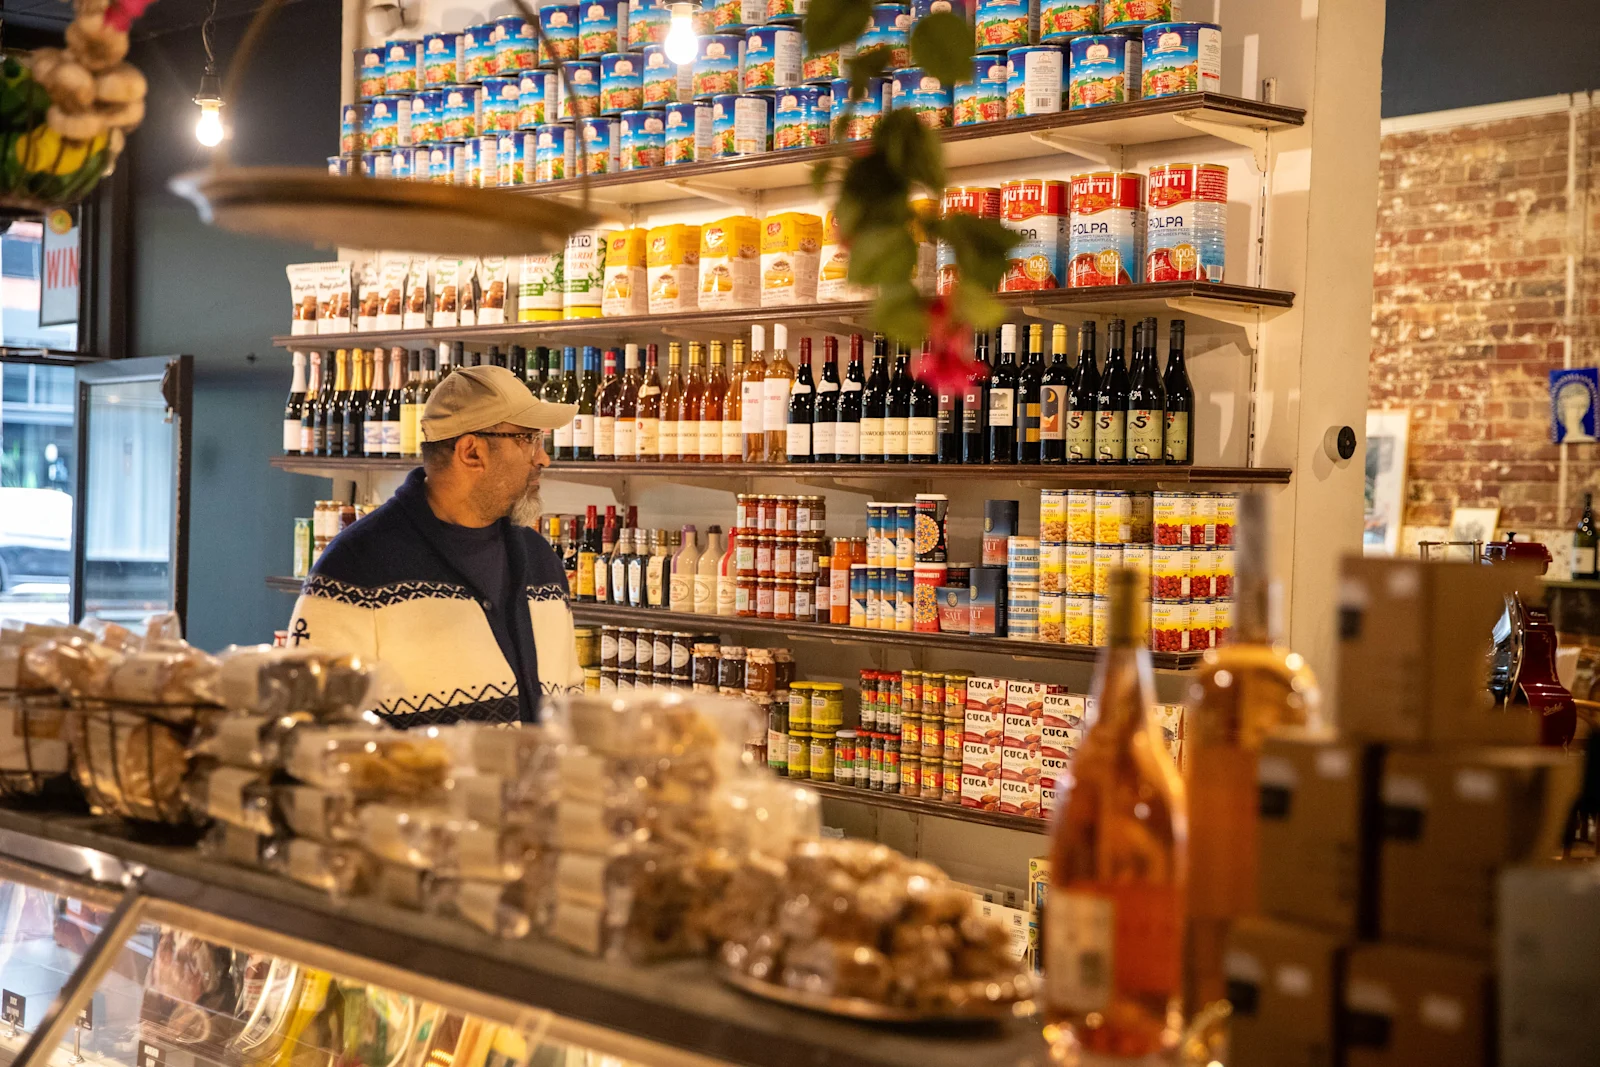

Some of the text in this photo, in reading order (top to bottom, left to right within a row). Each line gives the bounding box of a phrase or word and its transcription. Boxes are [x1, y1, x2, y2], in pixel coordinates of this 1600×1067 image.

[1150, 174, 1185, 188] MUTTI
[1072, 182, 1110, 195] MUTTI
[1002, 188, 1039, 204] MUTTI
[1148, 216, 1184, 230] POLPA
[1072, 222, 1108, 237] POLPA
[945, 612, 963, 622] SALT
[969, 680, 993, 690] CUCA
[1009, 684, 1033, 694] CUCA
[1044, 696, 1070, 706] CUCA
[966, 712, 991, 723] CUCA
[1006, 717, 1031, 727] CUCA
[1042, 728, 1069, 738] CUCA
[964, 745, 988, 755] CUCA
[1004, 750, 1028, 760] CUCA
[1042, 759, 1068, 769] CUCA
[963, 777, 987, 788] CUCA
[1002, 783, 1027, 793] CUCA
